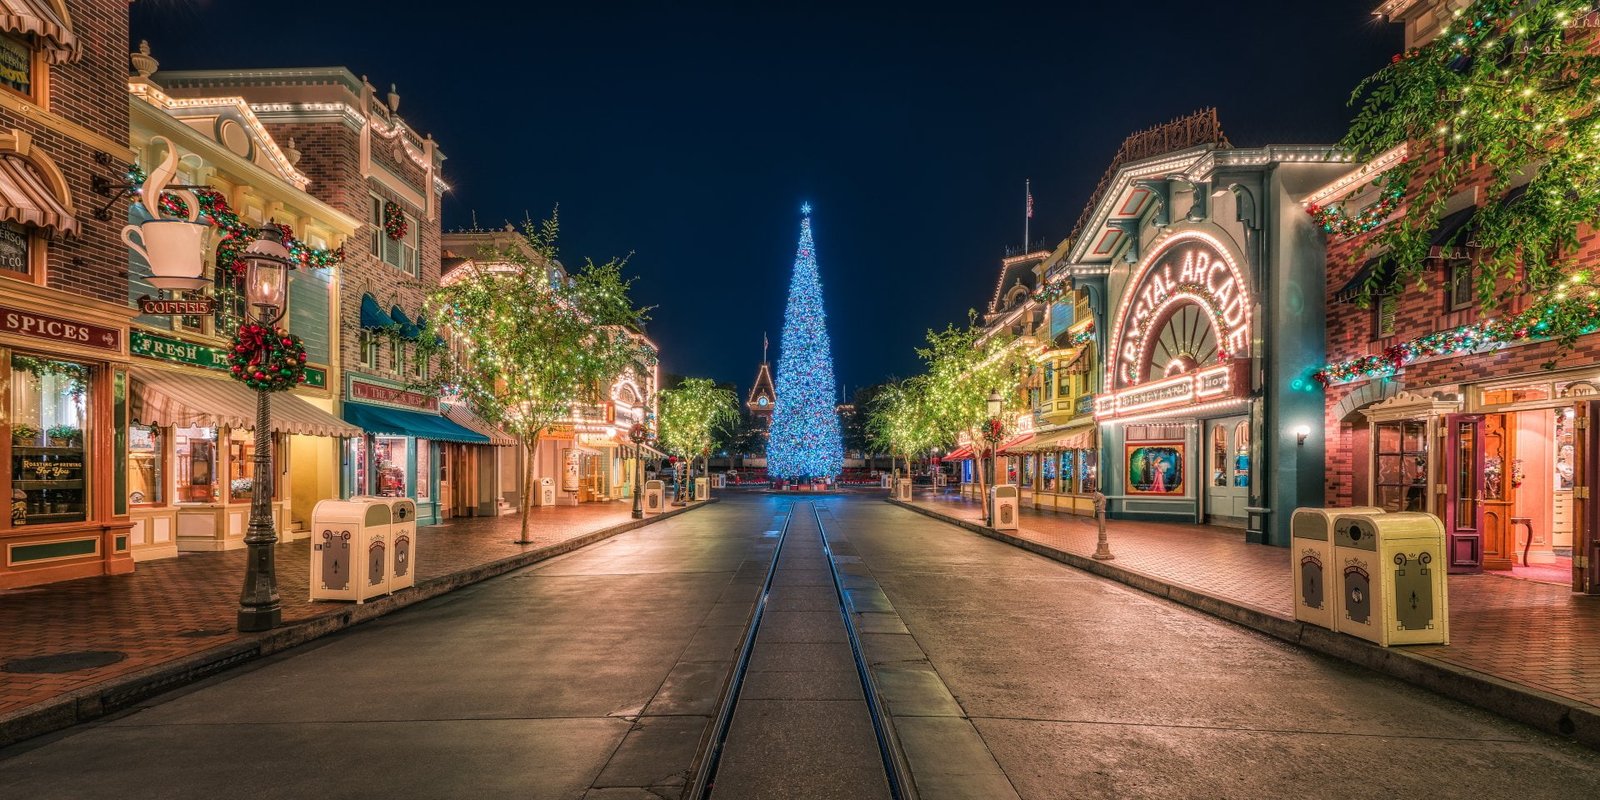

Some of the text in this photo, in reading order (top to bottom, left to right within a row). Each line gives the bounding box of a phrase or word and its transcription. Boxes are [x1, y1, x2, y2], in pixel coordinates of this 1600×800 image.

[144, 301, 210, 314] COFFEE
[1121, 250, 1248, 383] CRYSTAL ARCADE
[6, 313, 90, 341] SPICES
[142, 338, 197, 360] FRESH
